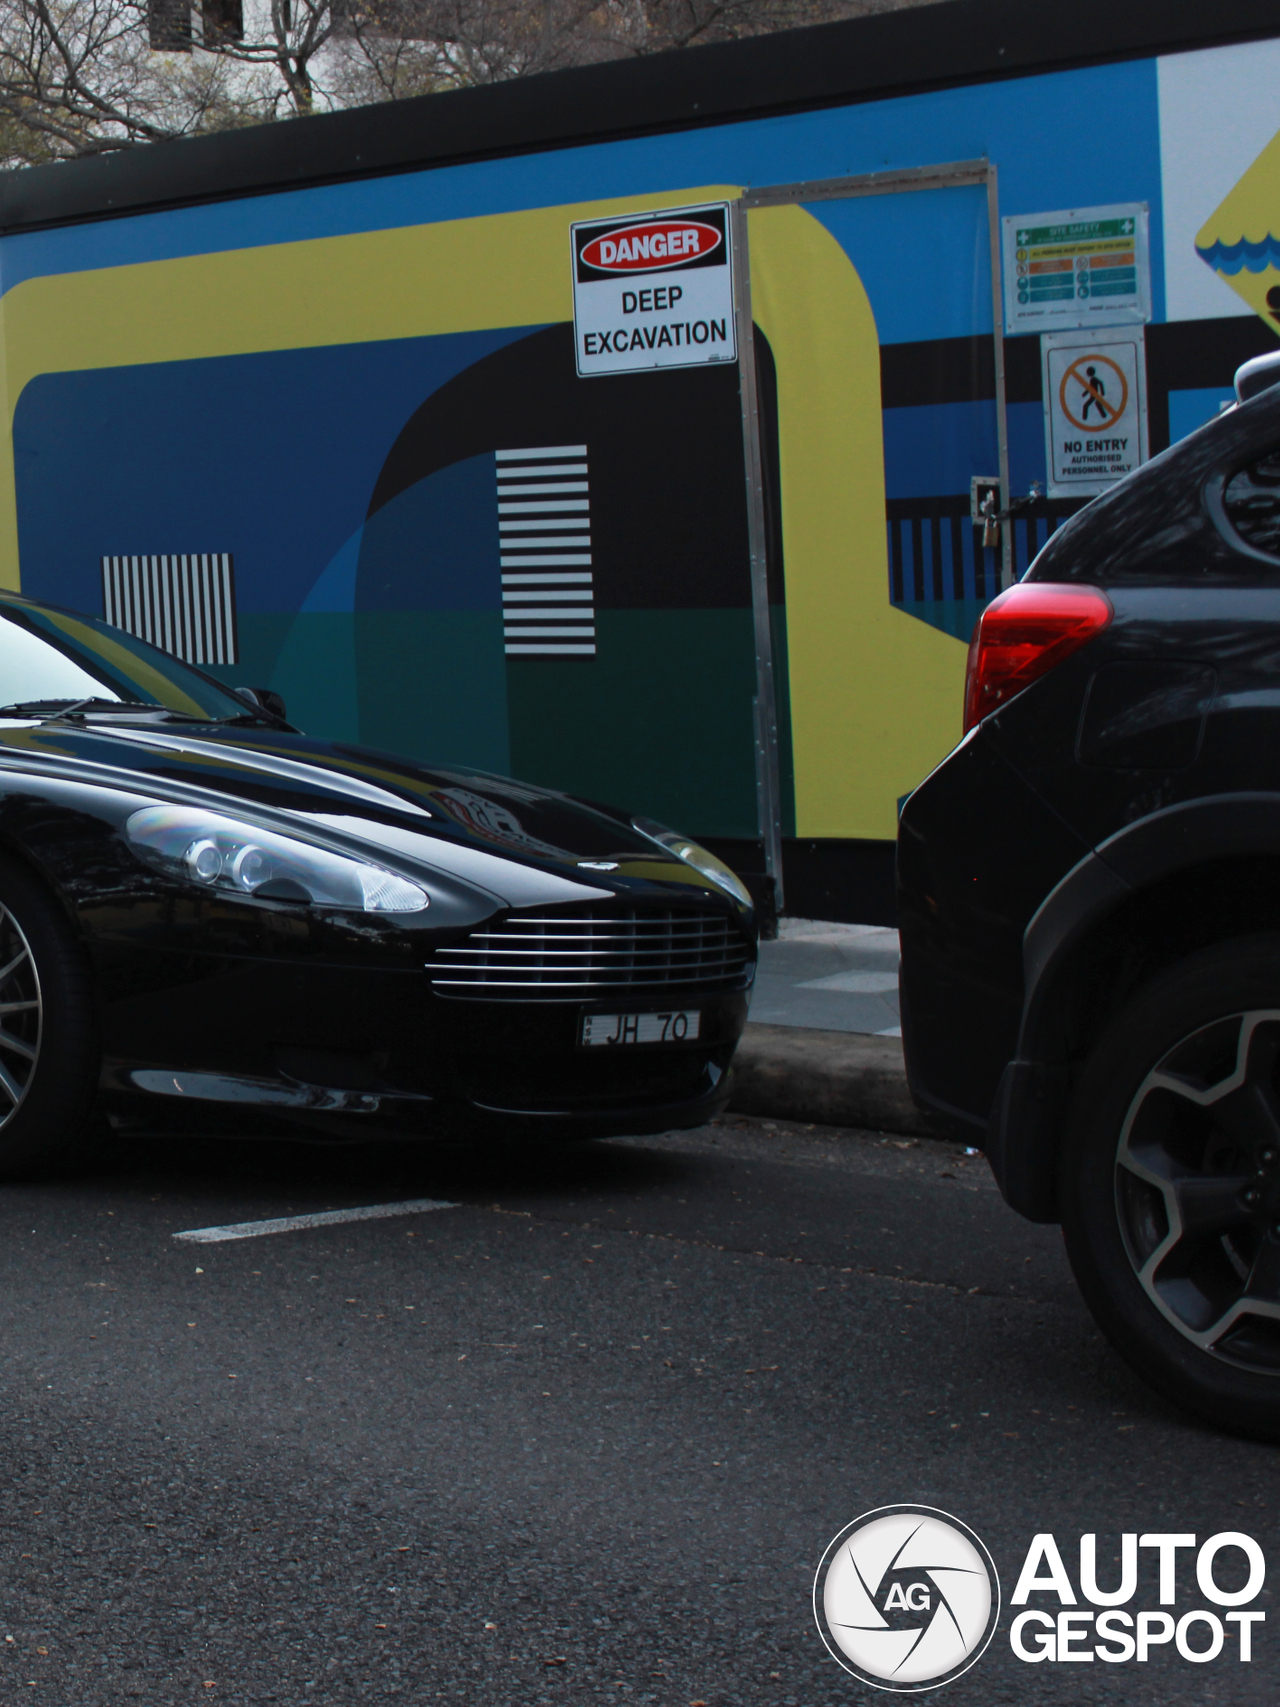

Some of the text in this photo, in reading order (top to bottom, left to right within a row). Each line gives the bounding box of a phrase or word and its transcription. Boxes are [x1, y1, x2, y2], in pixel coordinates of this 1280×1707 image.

[1070, 223, 1100, 234] SAFETY
[600, 229, 700, 265] DANGER
[622, 285, 683, 314] DEEP
[584, 318, 726, 355] EXCAVATION
[1064, 438, 1128, 453] NO ENTRY
[1062, 464, 1131, 475] PERSONNEL ONLY
[1071, 454, 1122, 464] AUTHORISED
[583, 1012, 688, 1045] NSW JH 70
